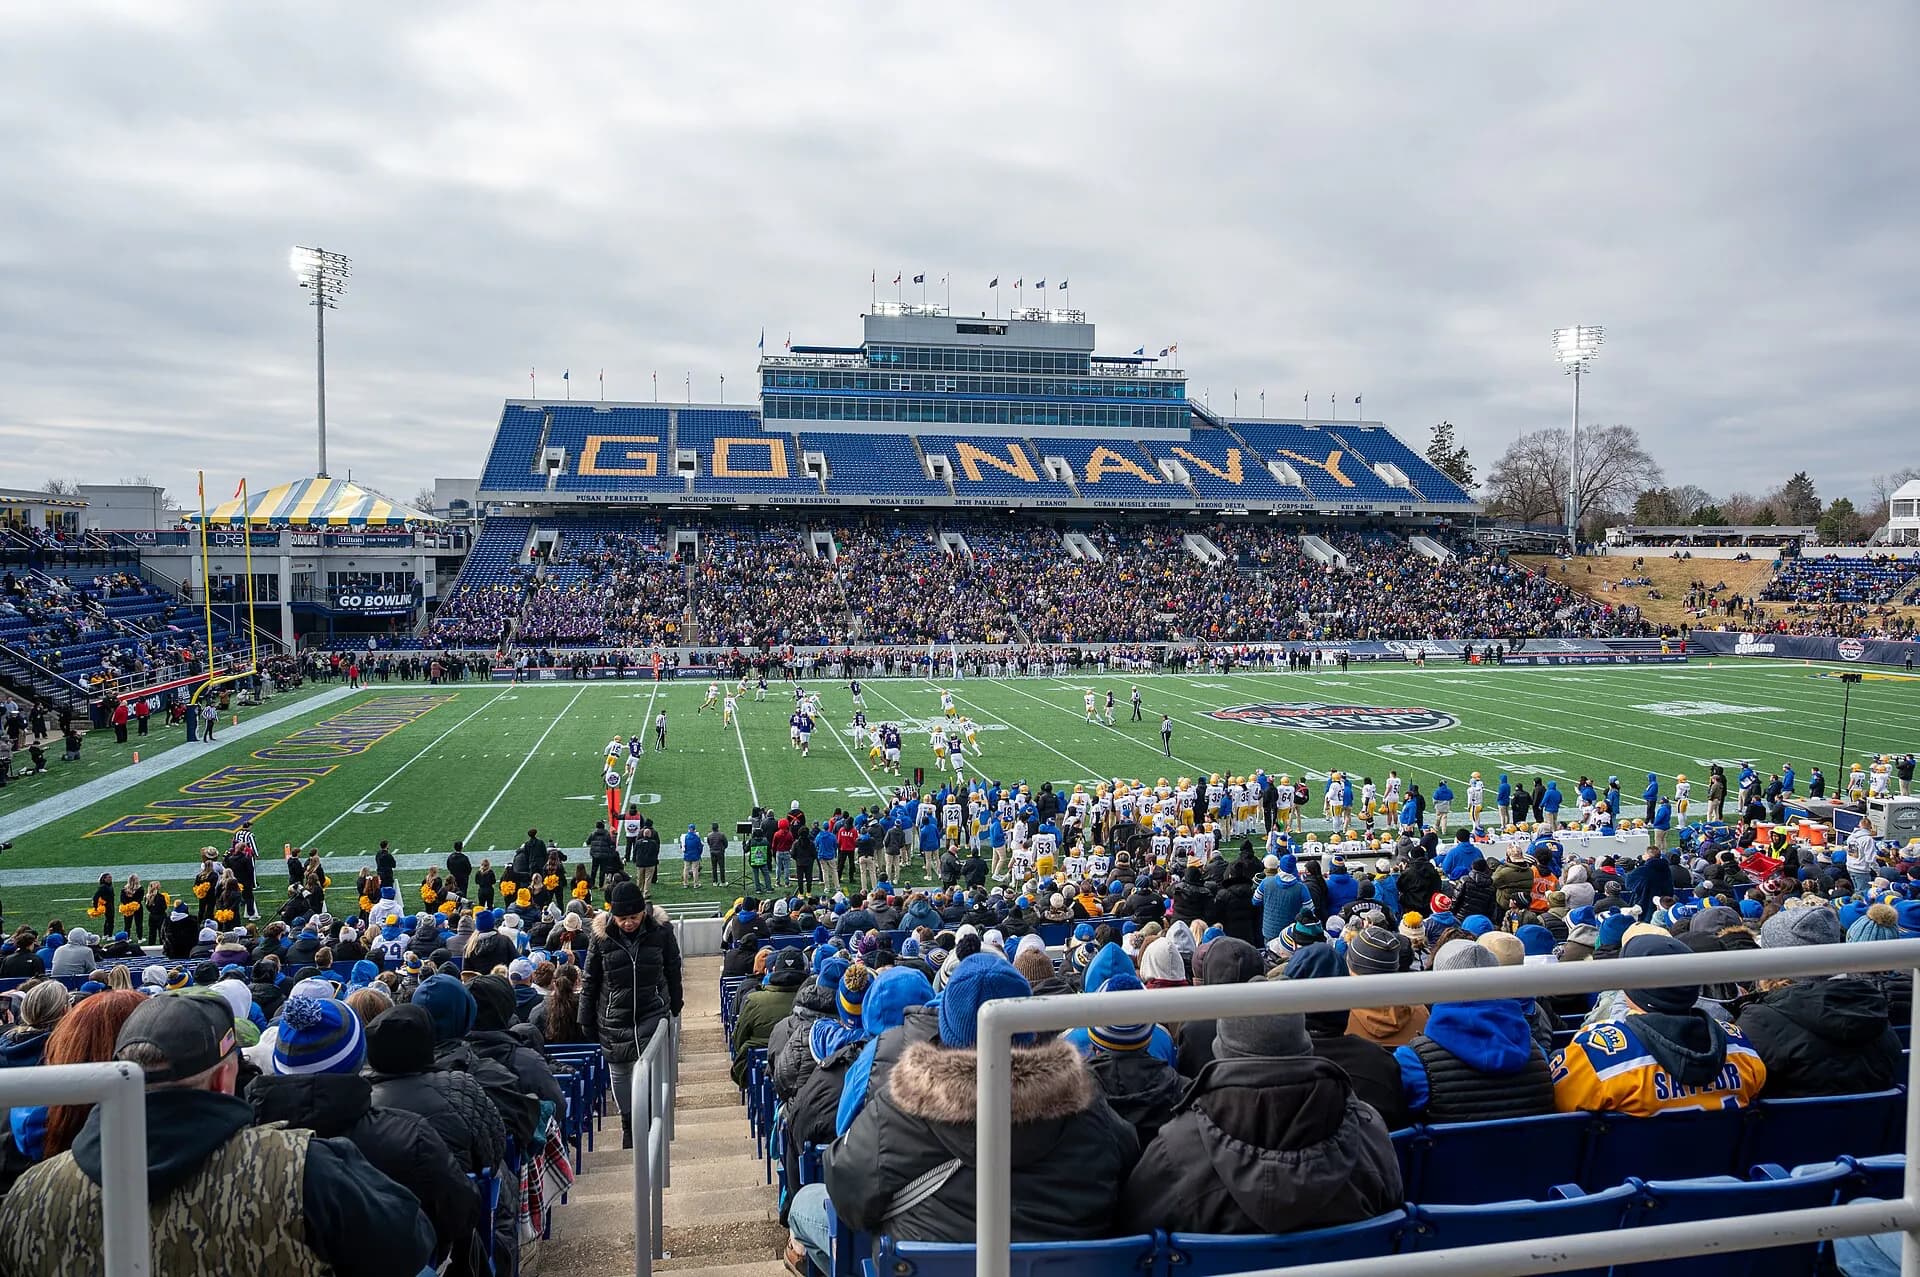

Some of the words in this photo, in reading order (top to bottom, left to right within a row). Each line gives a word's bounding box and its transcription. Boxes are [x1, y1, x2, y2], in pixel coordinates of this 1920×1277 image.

[577, 435, 789, 478] GO
[955, 442, 1355, 487] NAVY
[135, 532, 156, 540] CACI
[215, 533, 244, 544] DRB
[339, 595, 361, 607] GO
[364, 593, 412, 607] BOWLING
[1739, 634, 1754, 645] GO
[1734, 643, 1775, 655] BOWLING
[250, 692, 459, 760] CAROLINA
[80, 764, 340, 838] EAST
[352, 801, 392, 814] G
[947, 809, 959, 821] 22
[1899, 811, 1918, 819] ACC
[1038, 842, 1051, 855] 53
[1154, 844, 1167, 856] 60
[1071, 863, 1082, 874] 71
[1603, 1029, 1620, 1046] Pitt
